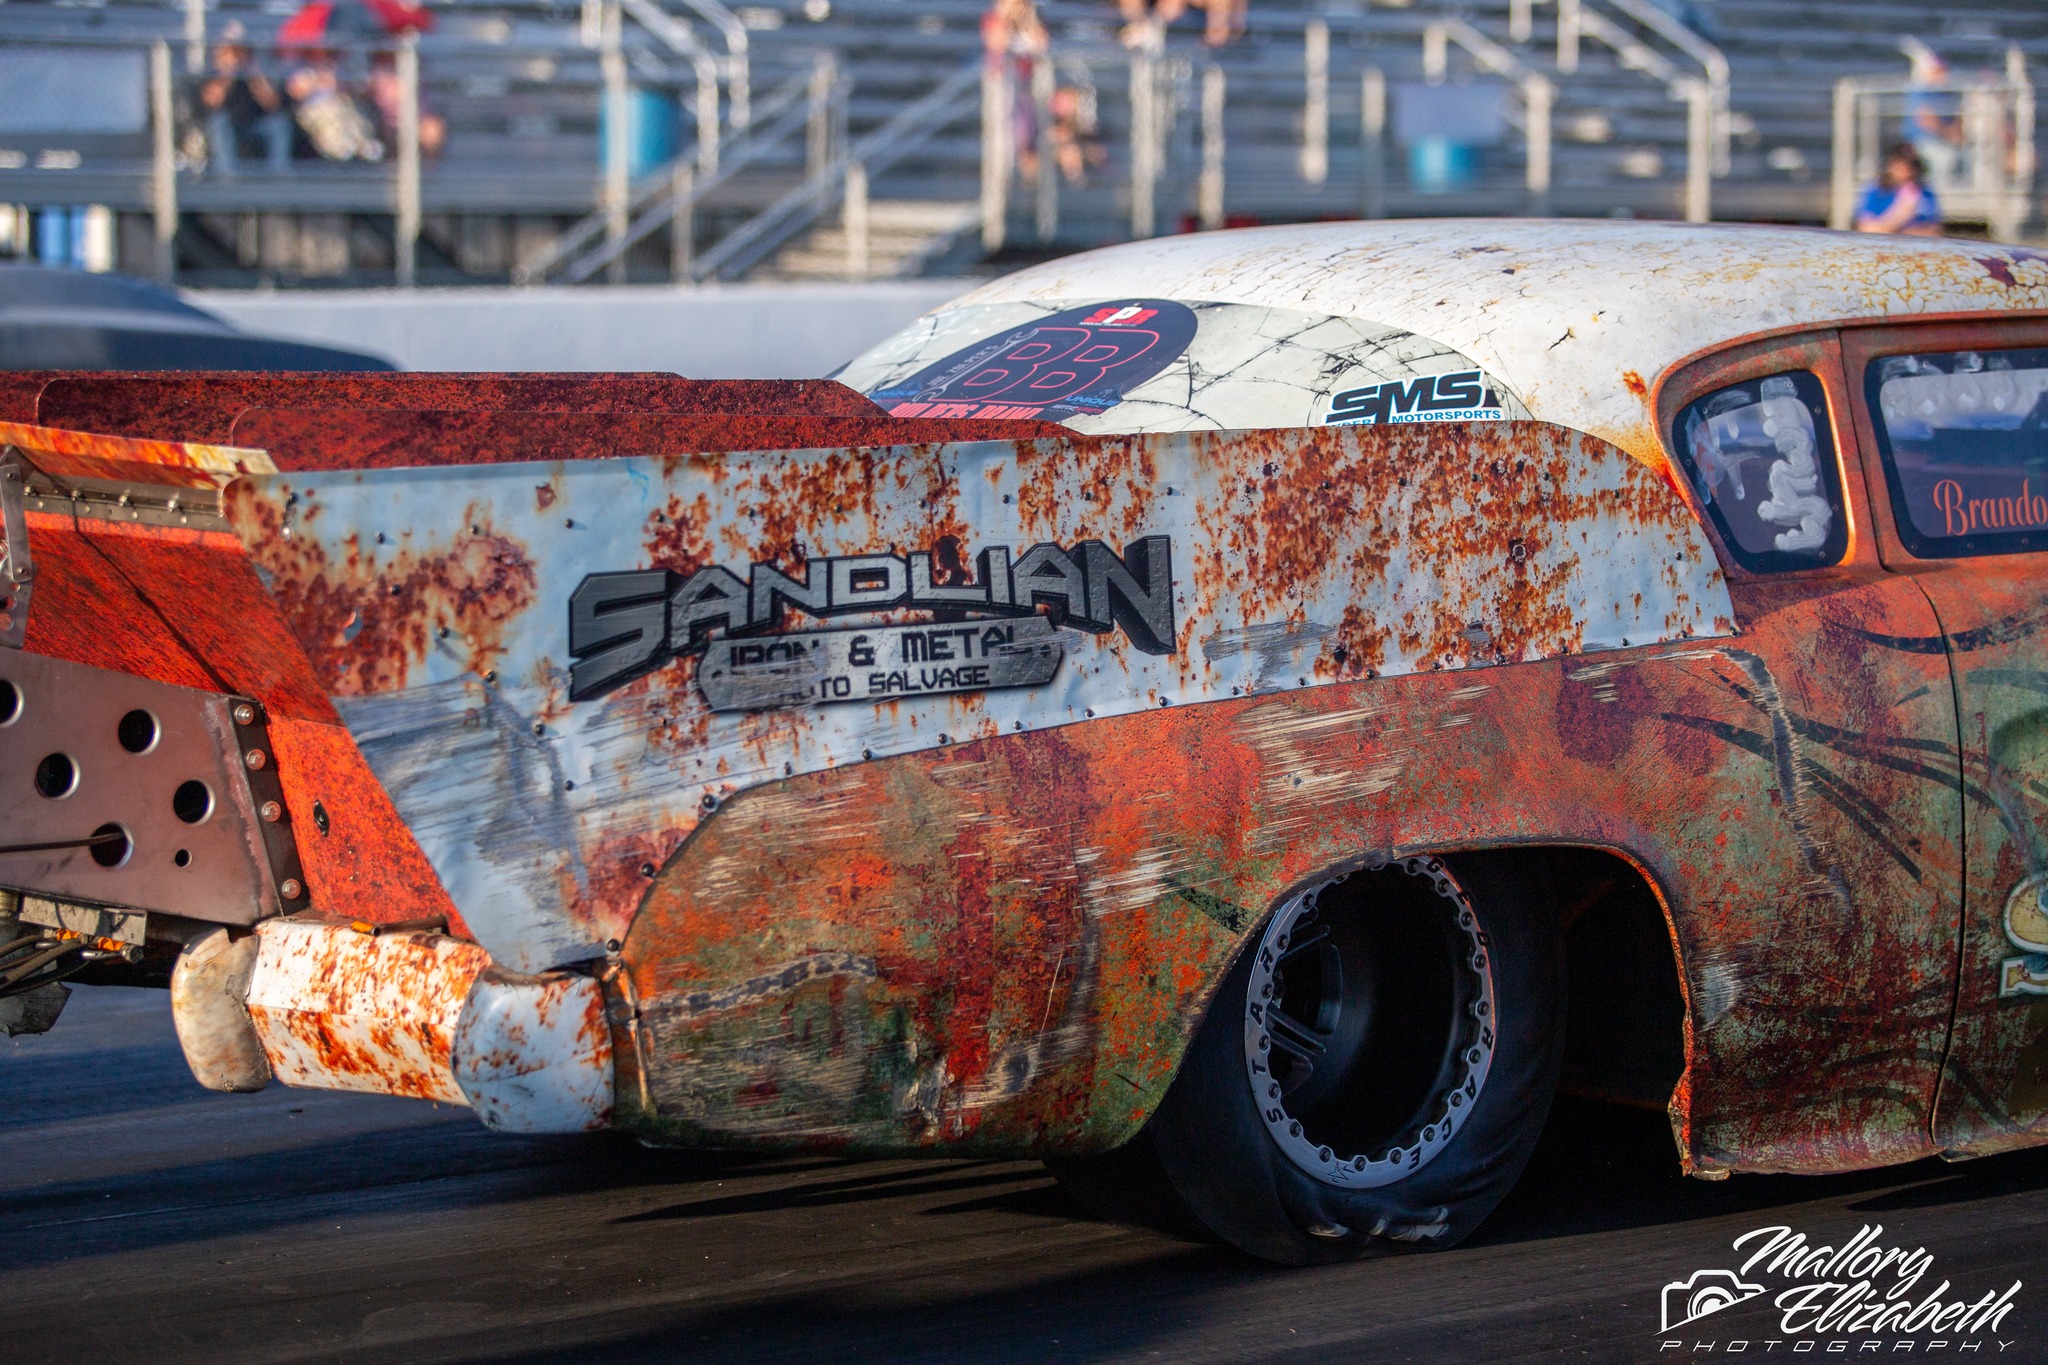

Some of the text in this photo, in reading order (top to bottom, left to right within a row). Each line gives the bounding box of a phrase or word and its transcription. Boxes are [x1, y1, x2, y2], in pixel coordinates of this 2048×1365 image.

[1325, 370, 1483, 424] SMS
[1391, 407, 1501, 424] MOTORSPORTS
[568, 535, 1176, 702] SANDLIAN
[848, 634, 876, 667] &
[868, 664, 990, 694] SALVAGE
